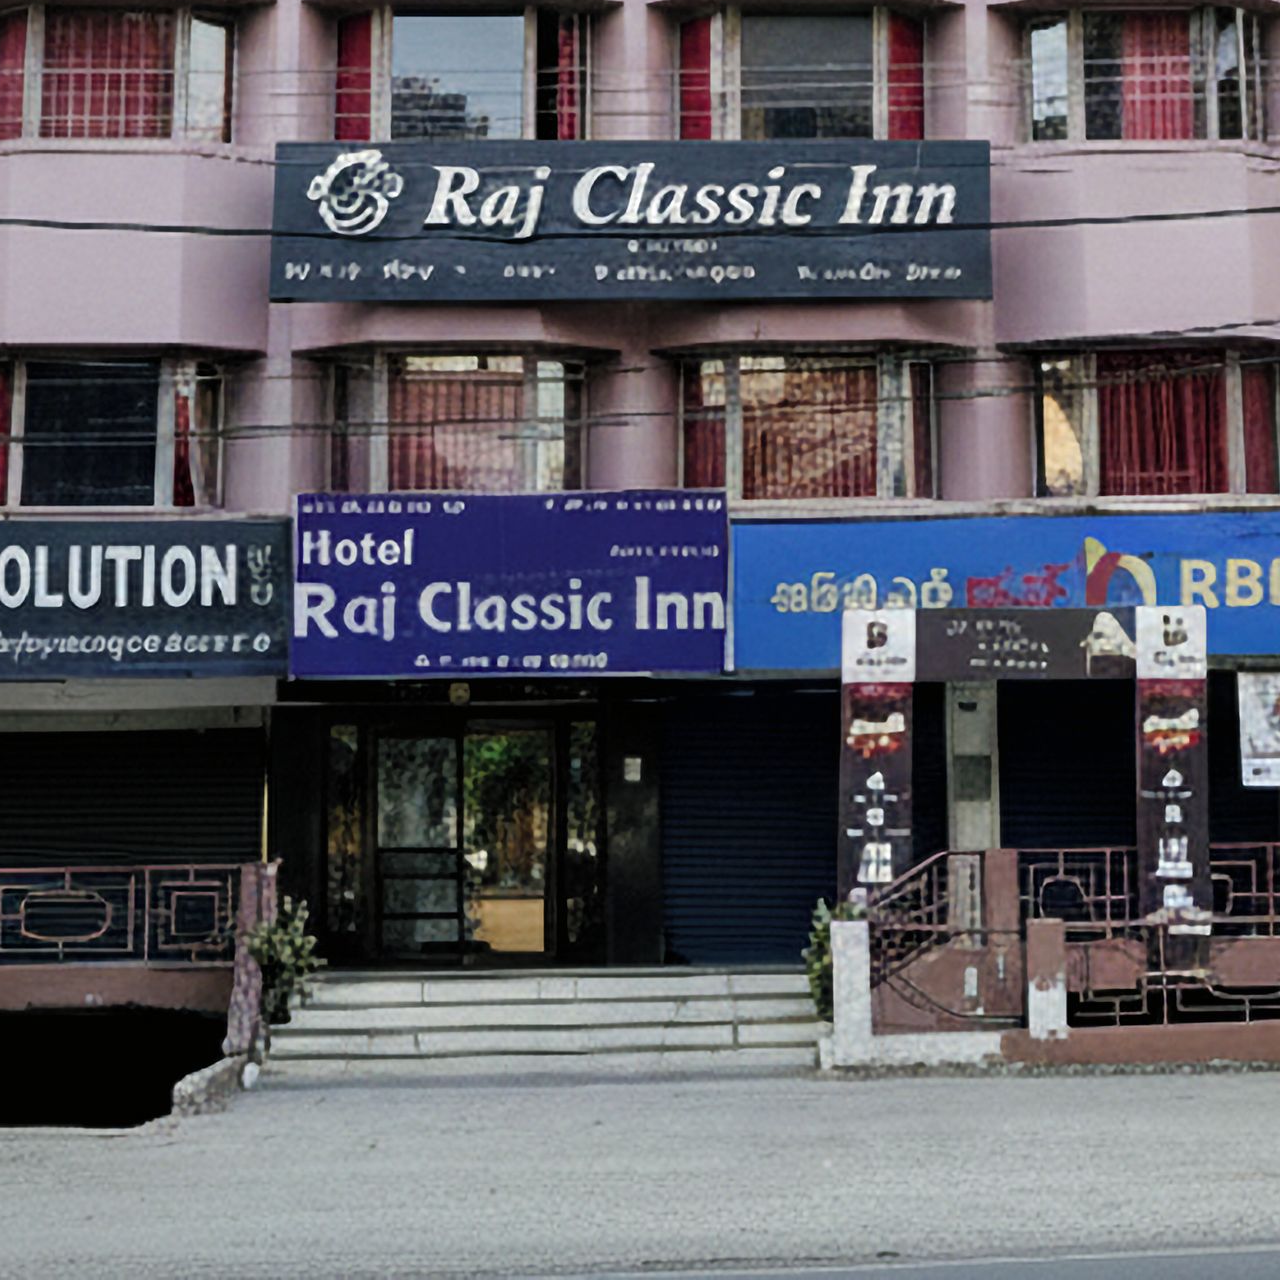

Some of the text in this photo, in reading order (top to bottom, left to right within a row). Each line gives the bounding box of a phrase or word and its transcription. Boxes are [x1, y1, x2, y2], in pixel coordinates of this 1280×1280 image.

[424, 162, 957, 238] Raj Classic Inn
[302, 528, 415, 566] Hotel
[293, 581, 397, 642] Raj
[419, 577, 613, 633] Classic
[635, 575, 726, 631] Inn
